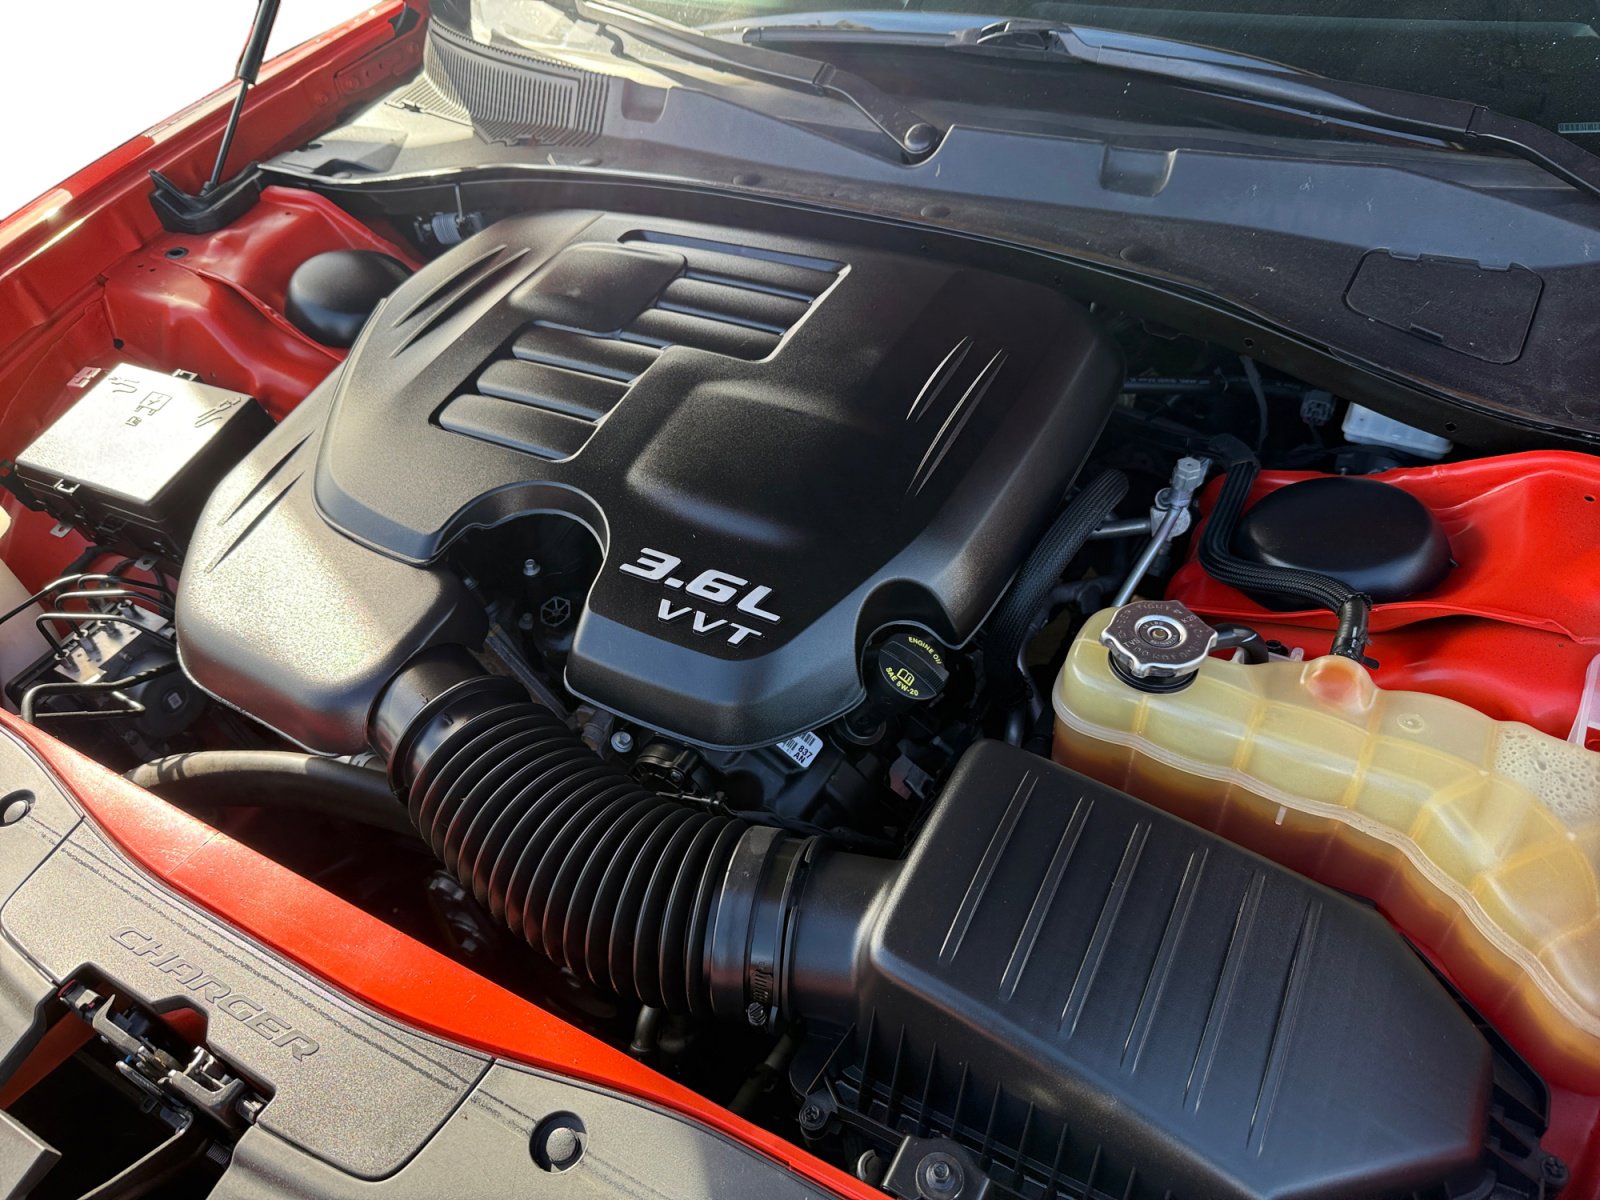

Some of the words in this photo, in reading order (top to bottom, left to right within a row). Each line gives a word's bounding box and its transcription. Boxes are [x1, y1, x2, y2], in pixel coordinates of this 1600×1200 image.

[619, 547, 782, 624] 3.6L
[657, 598, 763, 648] VVT
[908, 636, 934, 654] ENGINE
[885, 667, 898, 681] SAE
[896, 681, 919, 696] 5W-20
[798, 745, 813, 759] 837
[109, 926, 320, 1062] CHARGER
